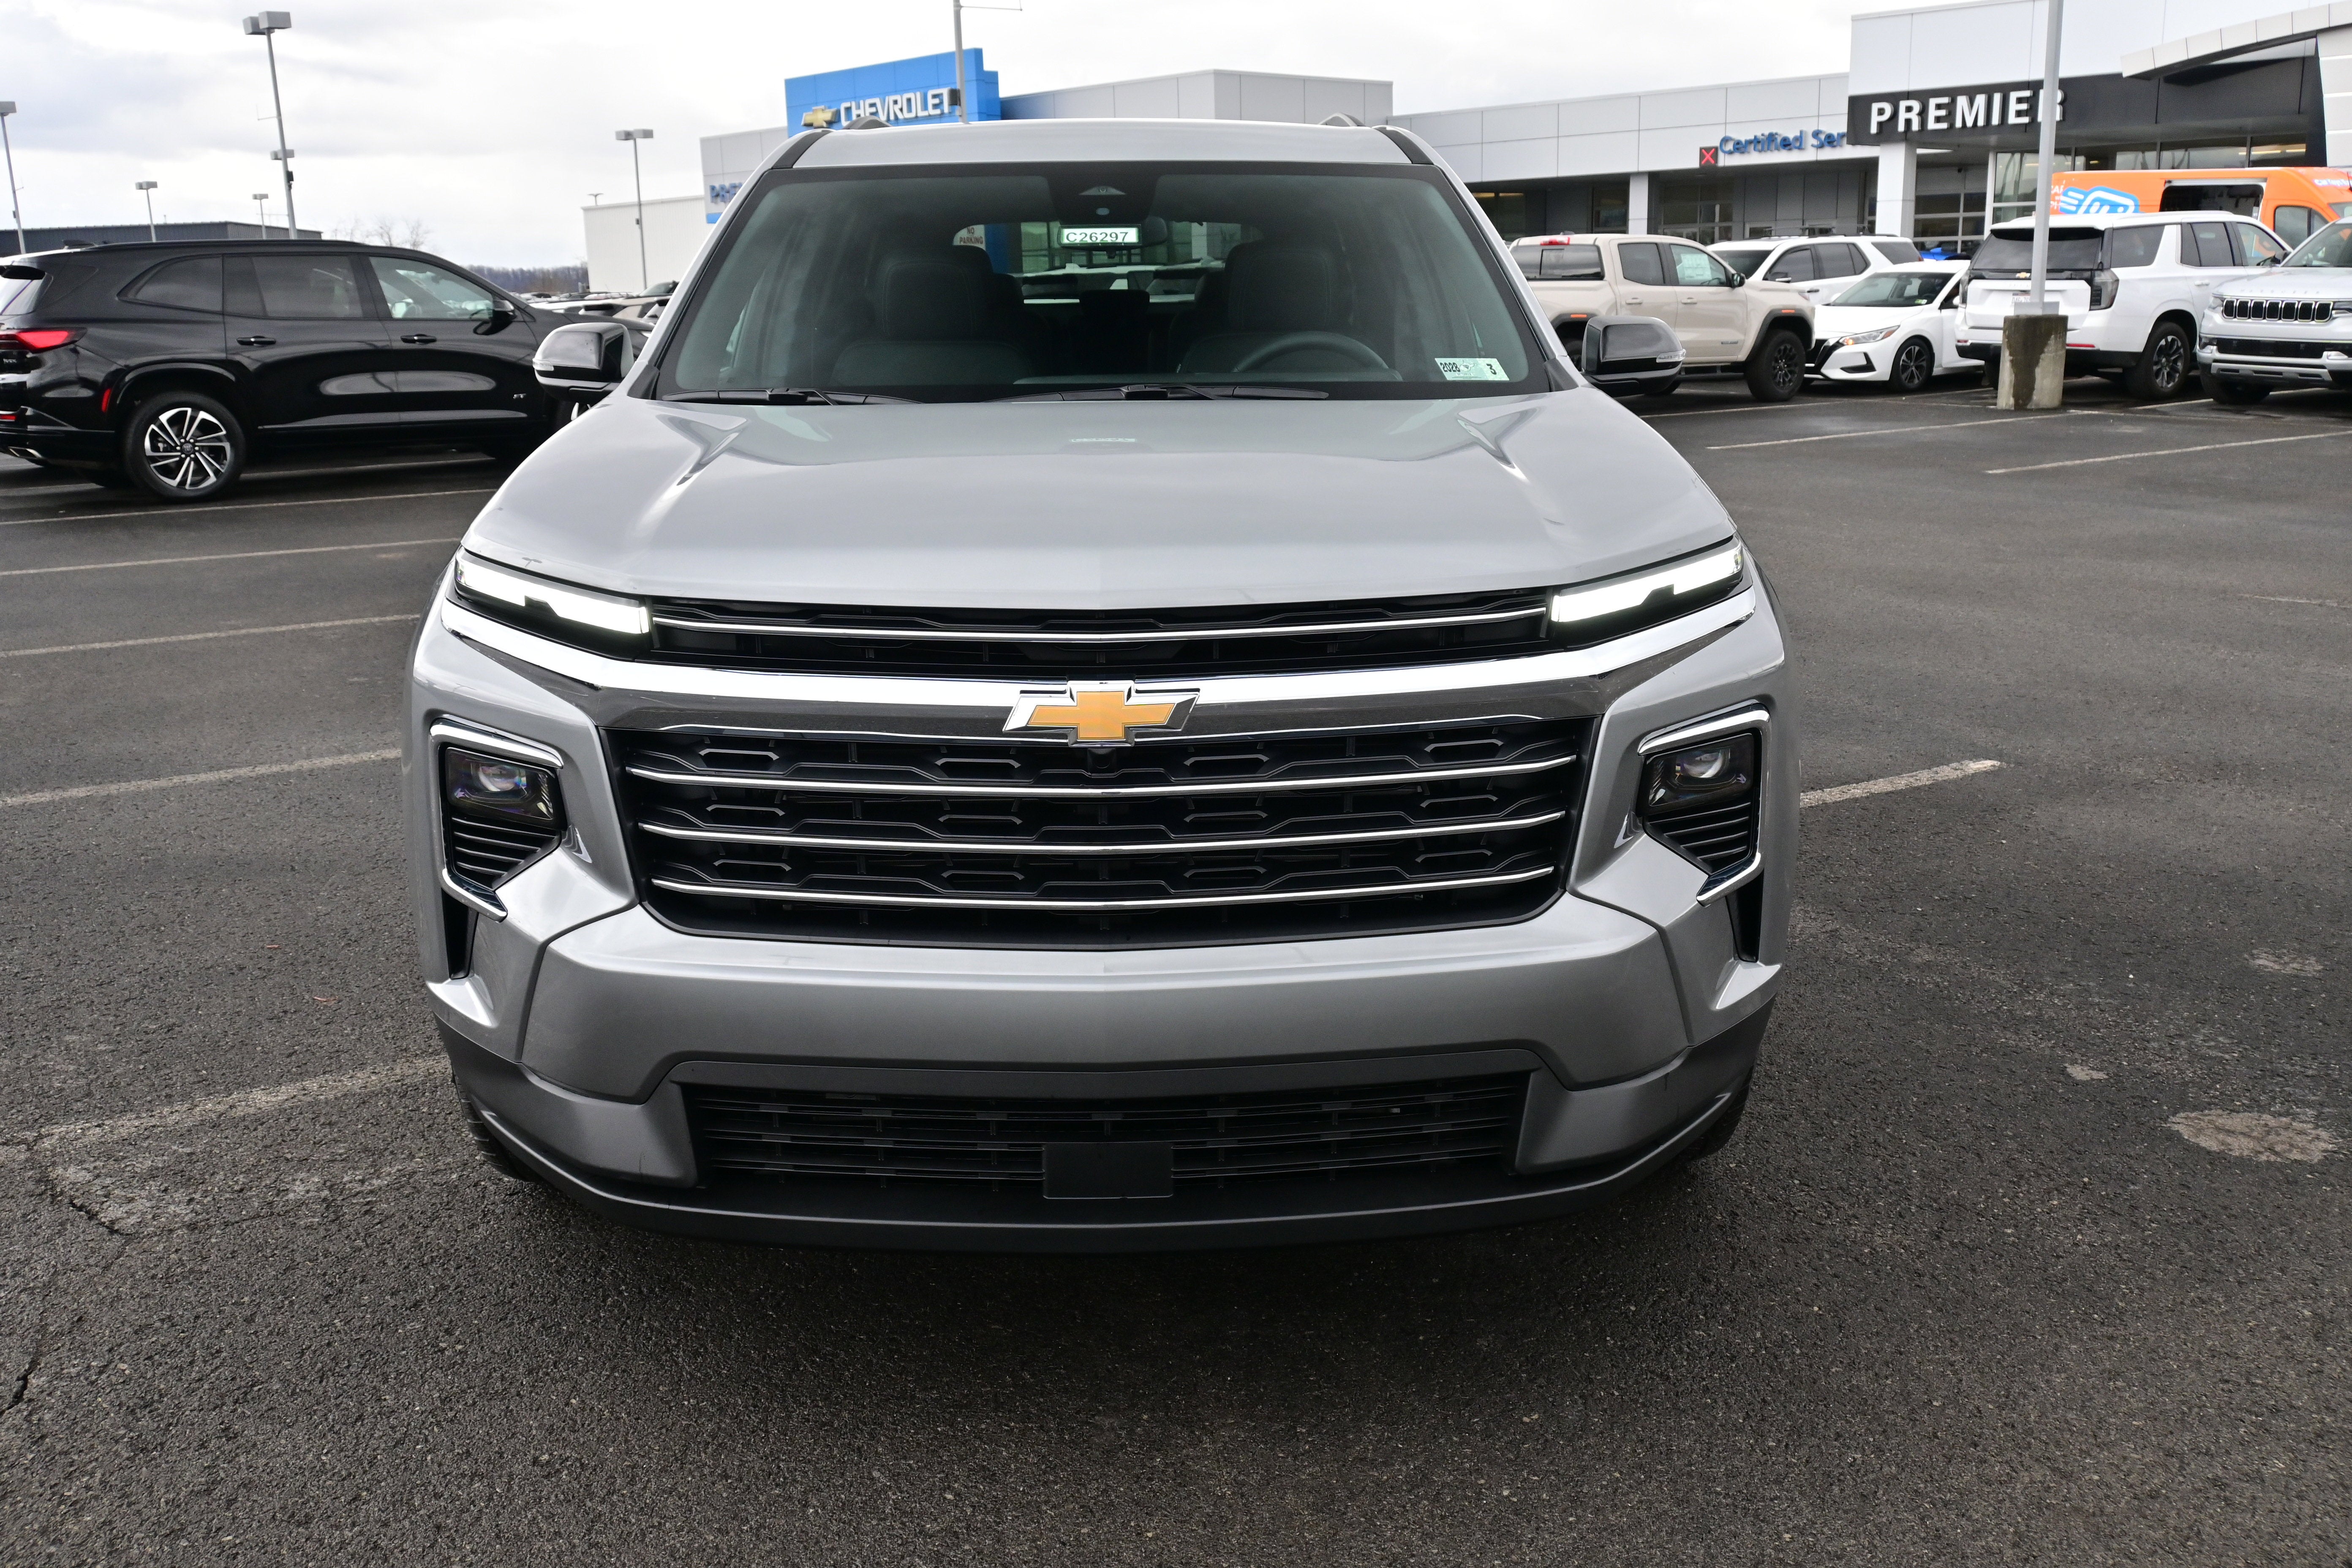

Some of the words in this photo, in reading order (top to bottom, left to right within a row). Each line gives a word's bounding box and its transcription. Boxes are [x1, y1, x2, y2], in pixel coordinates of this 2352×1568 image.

[840, 87, 951, 126] CHEVROLET
[1719, 129, 1805, 154] Certified
[1811, 129, 1847, 148] Ser
[709, 182, 743, 203] PRE
[959, 236, 983, 244] PARKING
[1066, 232, 1129, 242] C26297
[1440, 362, 1460, 373] 2028
[1486, 363, 1497, 375] 3
